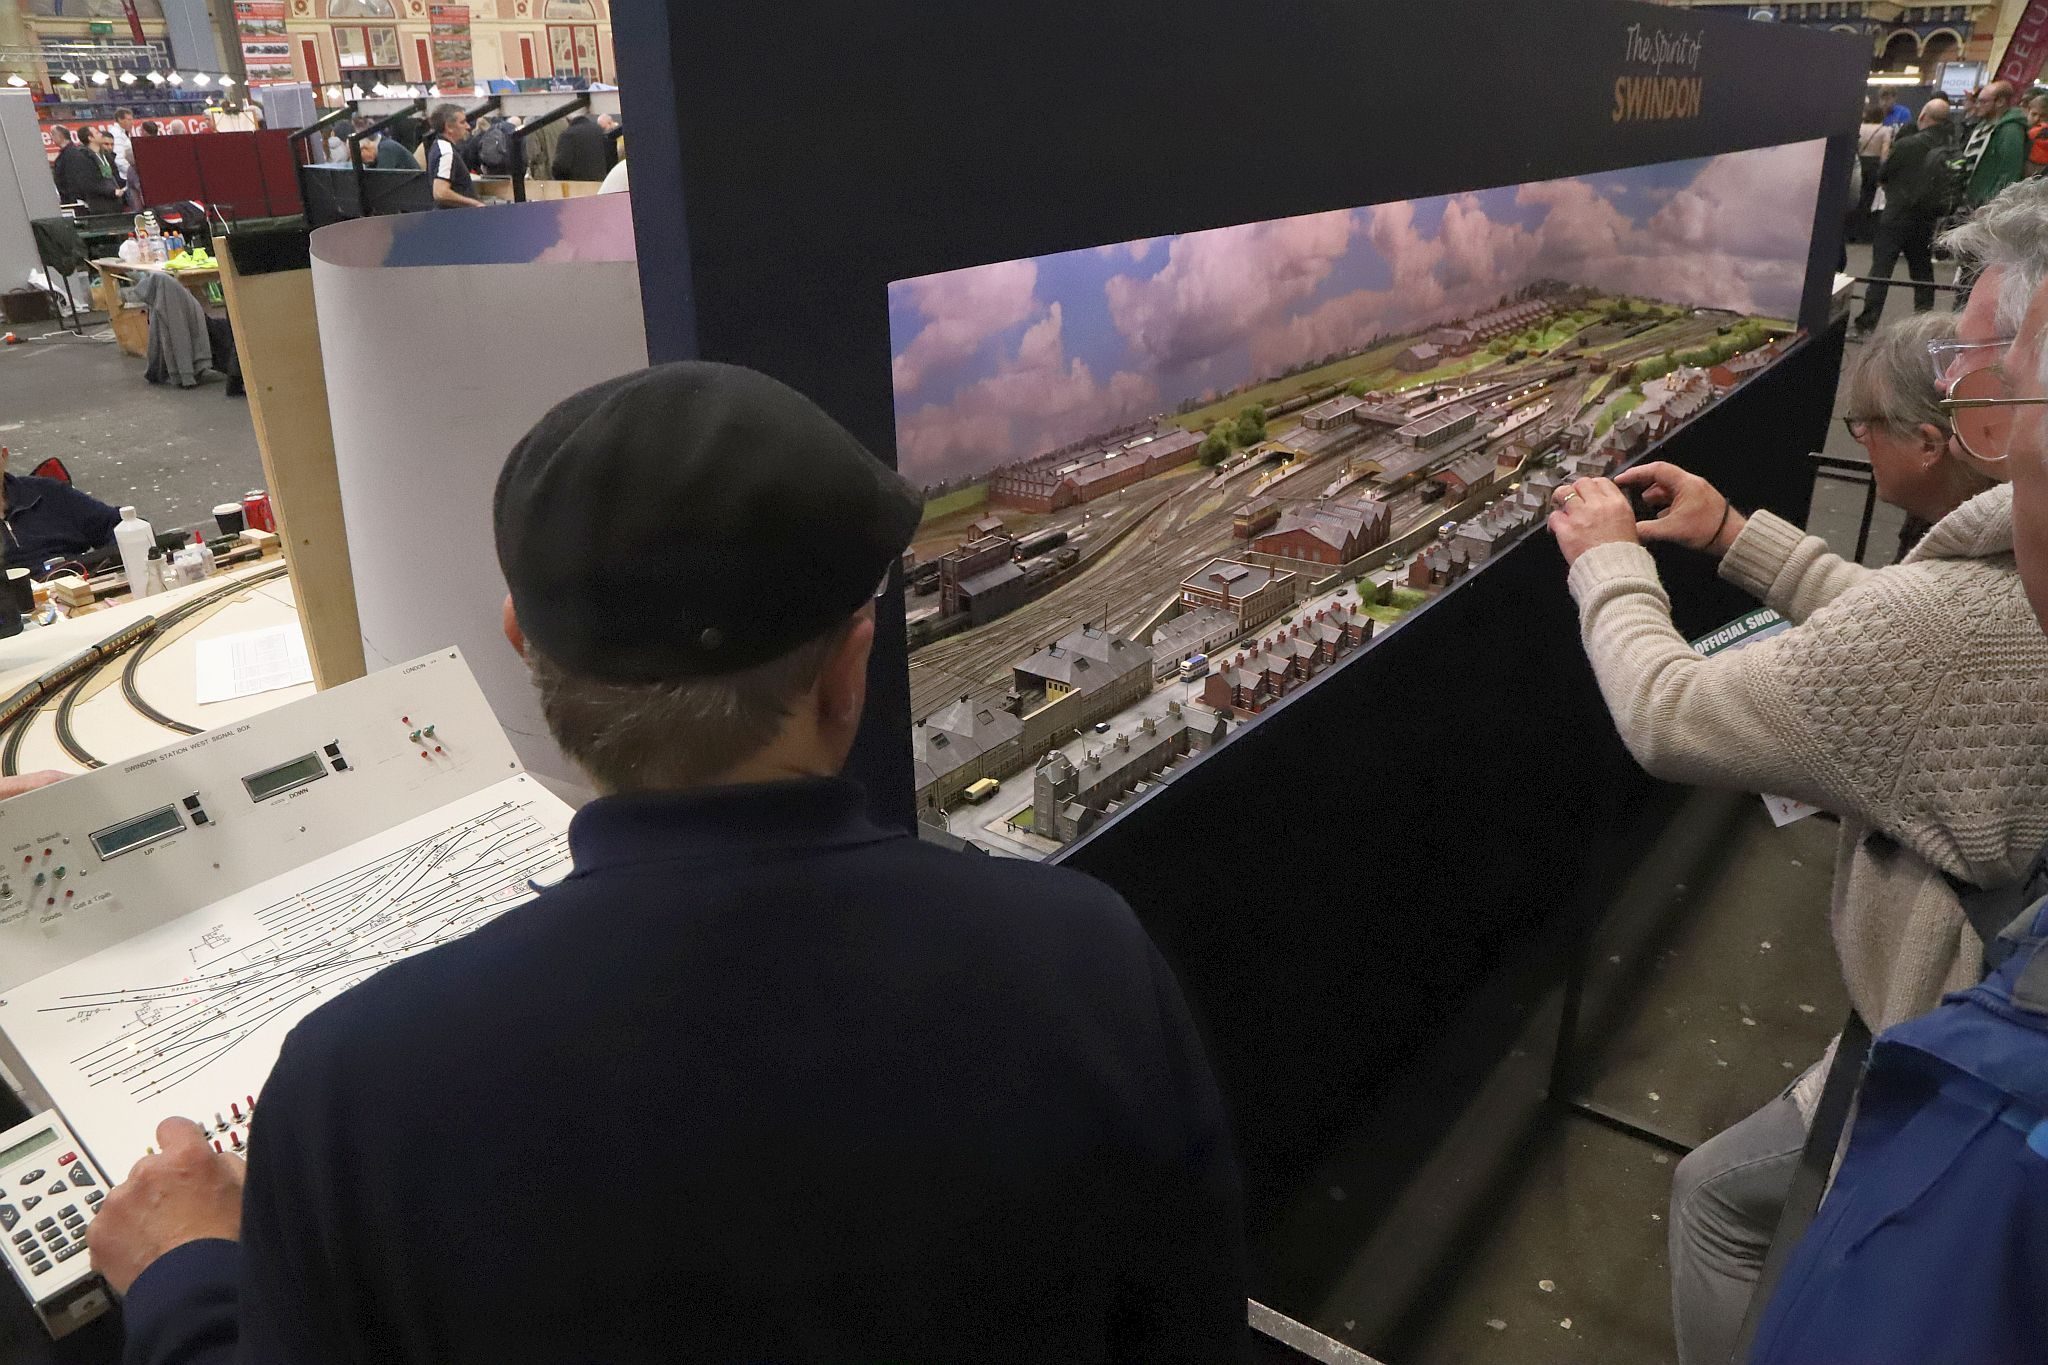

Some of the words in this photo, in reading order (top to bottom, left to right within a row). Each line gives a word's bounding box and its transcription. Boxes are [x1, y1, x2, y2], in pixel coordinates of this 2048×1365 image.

[1626, 23, 1650, 61] The
[1652, 30, 1688, 75] Spirit
[1689, 30, 1704, 71] of
[1612, 76, 1702, 121] SWINDON
[1694, 622, 1747, 655] OFFICIAL
[403, 663, 426, 674] LONDON
[124, 758, 157, 773] SWINDON
[160, 747, 188, 760] STATION
[190, 739, 208, 749] WEST
[211, 730, 235, 742] SIGNAL
[237, 724, 251, 733] BOX
[289, 788, 309, 799] DOWN
[144, 847, 154, 855] UP
[0, 909, 30, 924] ROTECT
[40, 912, 62, 923] Goods
